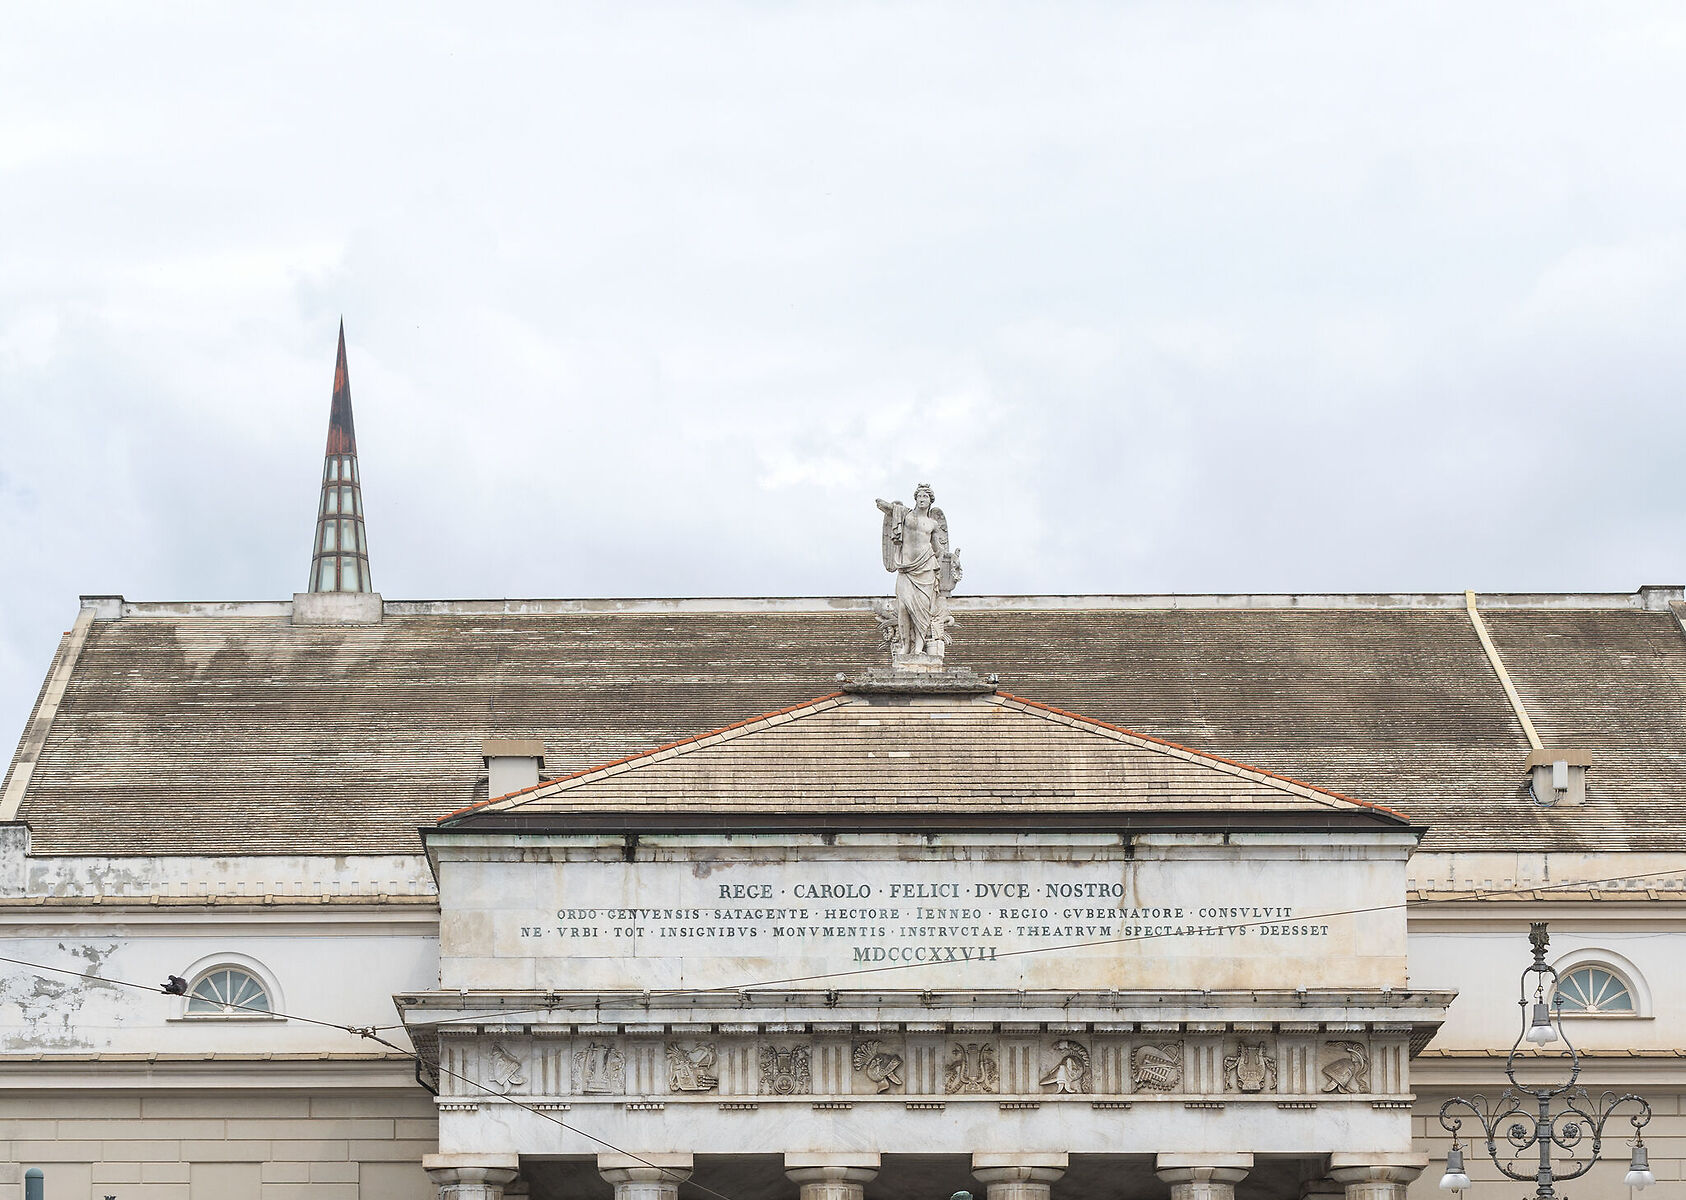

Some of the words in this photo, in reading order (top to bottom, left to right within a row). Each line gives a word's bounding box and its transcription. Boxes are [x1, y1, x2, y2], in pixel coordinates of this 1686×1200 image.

[717, 884, 773, 899] REGE
[793, 884, 872, 898] CAROLO
[889, 884, 960, 898] FELICI
[973, 884, 1031, 898] DVCE
[1045, 883, 1125, 897] NOSTRO
[557, 909, 598, 920] ORDO
[608, 909, 700, 920] GENVENSIS
[713, 909, 809, 919] SATAGENTE
[823, 908, 900, 919] HECTORE
[998, 908, 1049, 919] REGIO
[1062, 908, 1184, 918] GVBERNATORE
[1198, 907, 1293, 918] CONSVLVIT
[520, 927, 543, 938] NE
[556, 927, 599, 938] VRBI
[613, 927, 645, 938] TOT
[659, 926, 758, 937] INSIGNIBVS
[771, 926, 886, 937] MONVMENTIS
[899, 926, 1004, 937] INSTRVCTAE
[1016, 926, 1112, 936] THEATRVM
[1259, 925, 1330, 936] DEESSET
[853, 946, 998, 961] MDCCCXXVII
